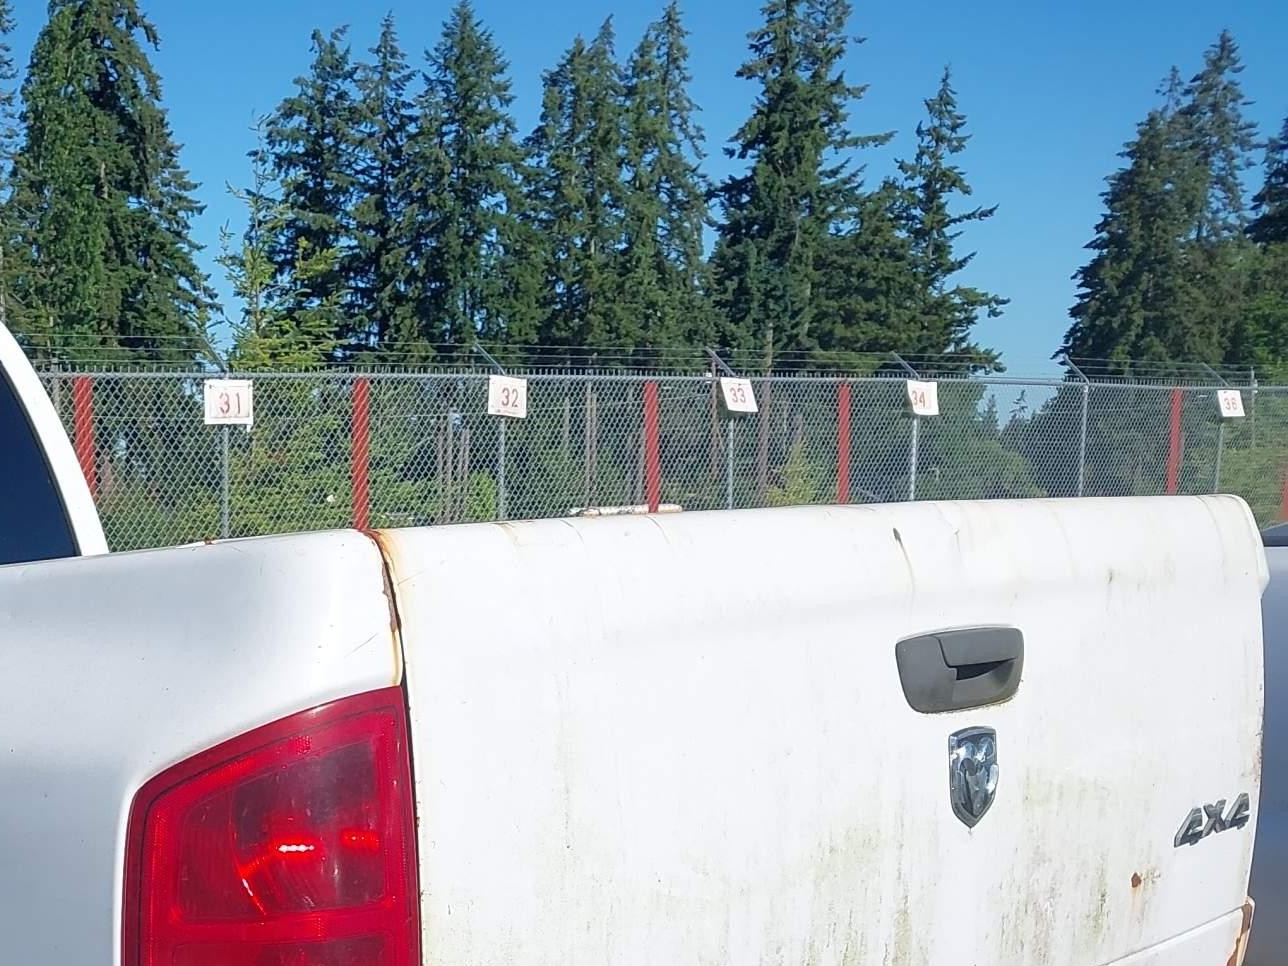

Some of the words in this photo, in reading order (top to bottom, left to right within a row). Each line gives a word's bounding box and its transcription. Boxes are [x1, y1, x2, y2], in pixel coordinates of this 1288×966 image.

[219, 392, 241, 415] 31
[502, 387, 519, 408] 32
[729, 387, 746, 403] 33
[911, 390, 926, 408] 34
